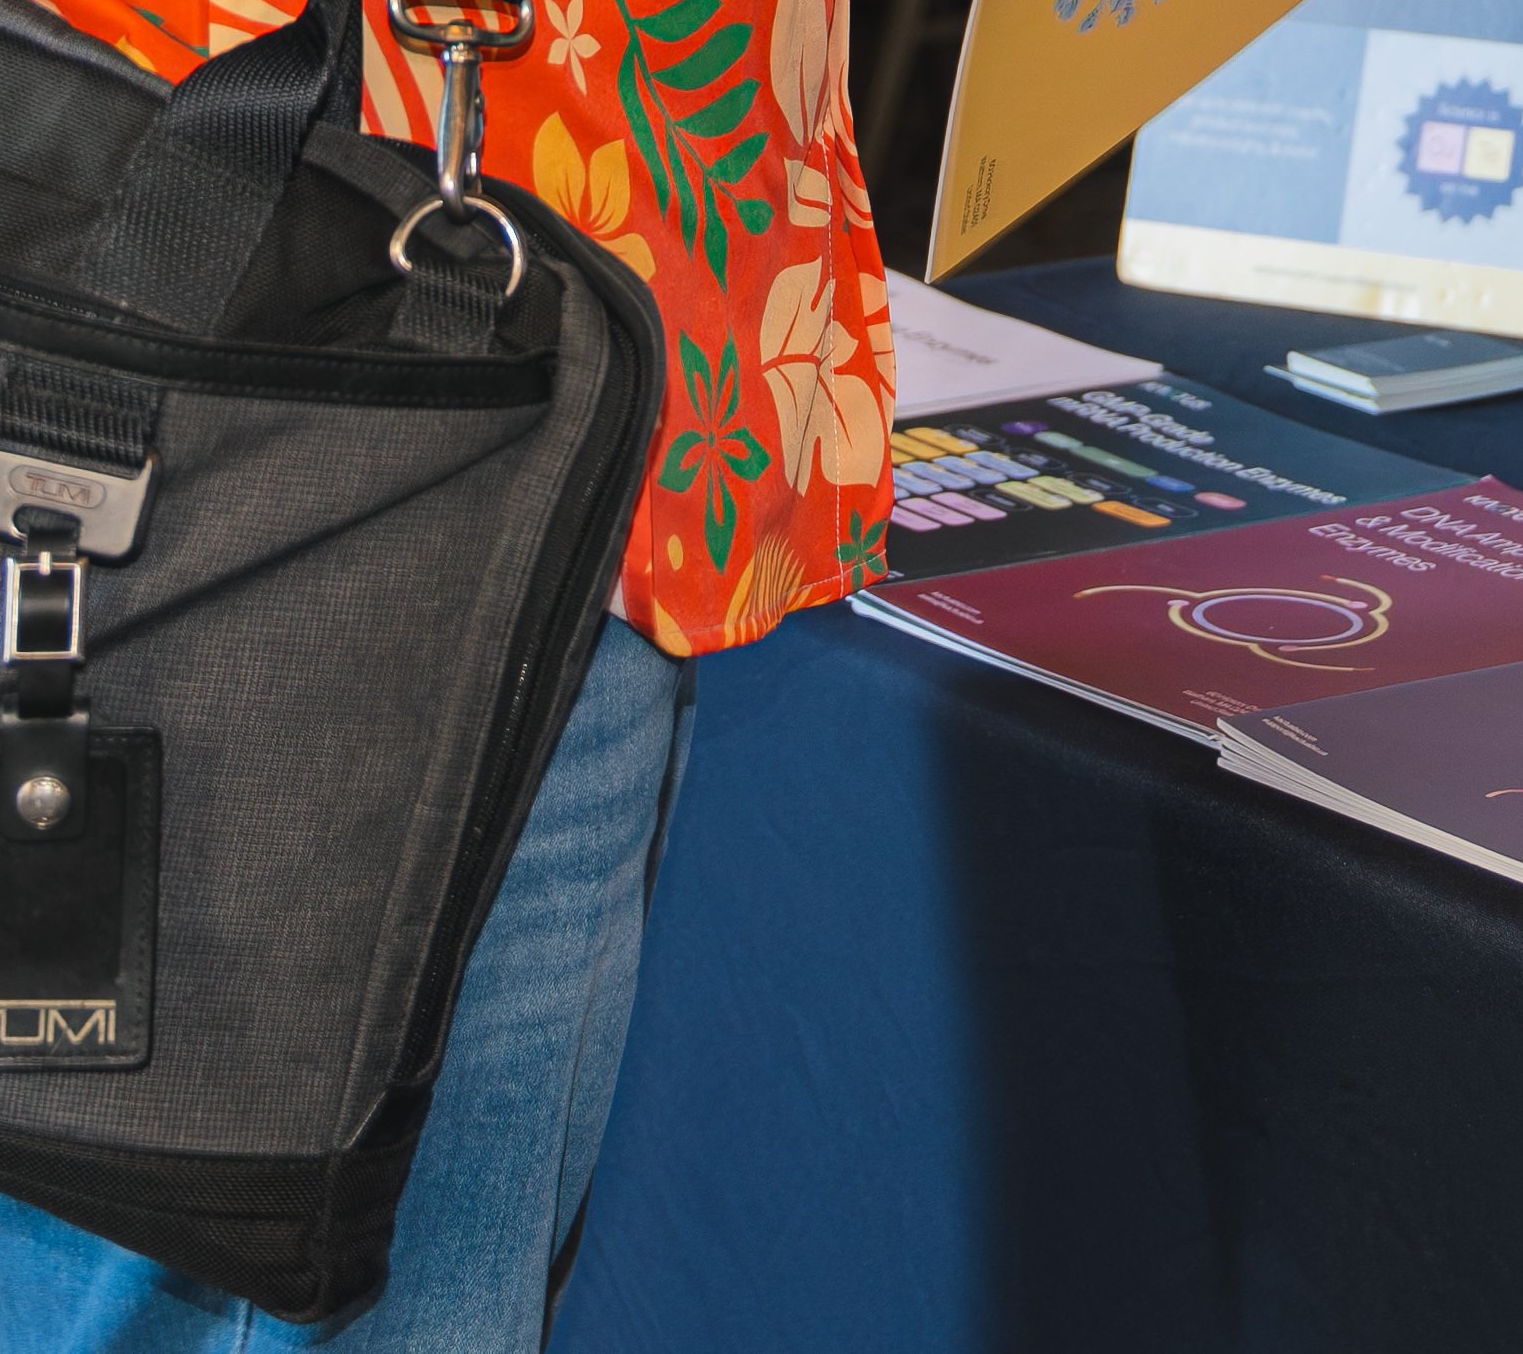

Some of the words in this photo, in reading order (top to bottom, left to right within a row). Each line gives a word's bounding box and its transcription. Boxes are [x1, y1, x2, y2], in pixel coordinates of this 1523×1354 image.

[1047, 395, 1130, 434] mRNA
[1116, 419, 1241, 480] Production
[1235, 464, 1348, 506] Enzymes
[23, 470, 94, 505] TUMI
[1354, 515, 1393, 530] &
[1399, 505, 1479, 538] DNA
[1307, 522, 1438, 573] Enzymes
